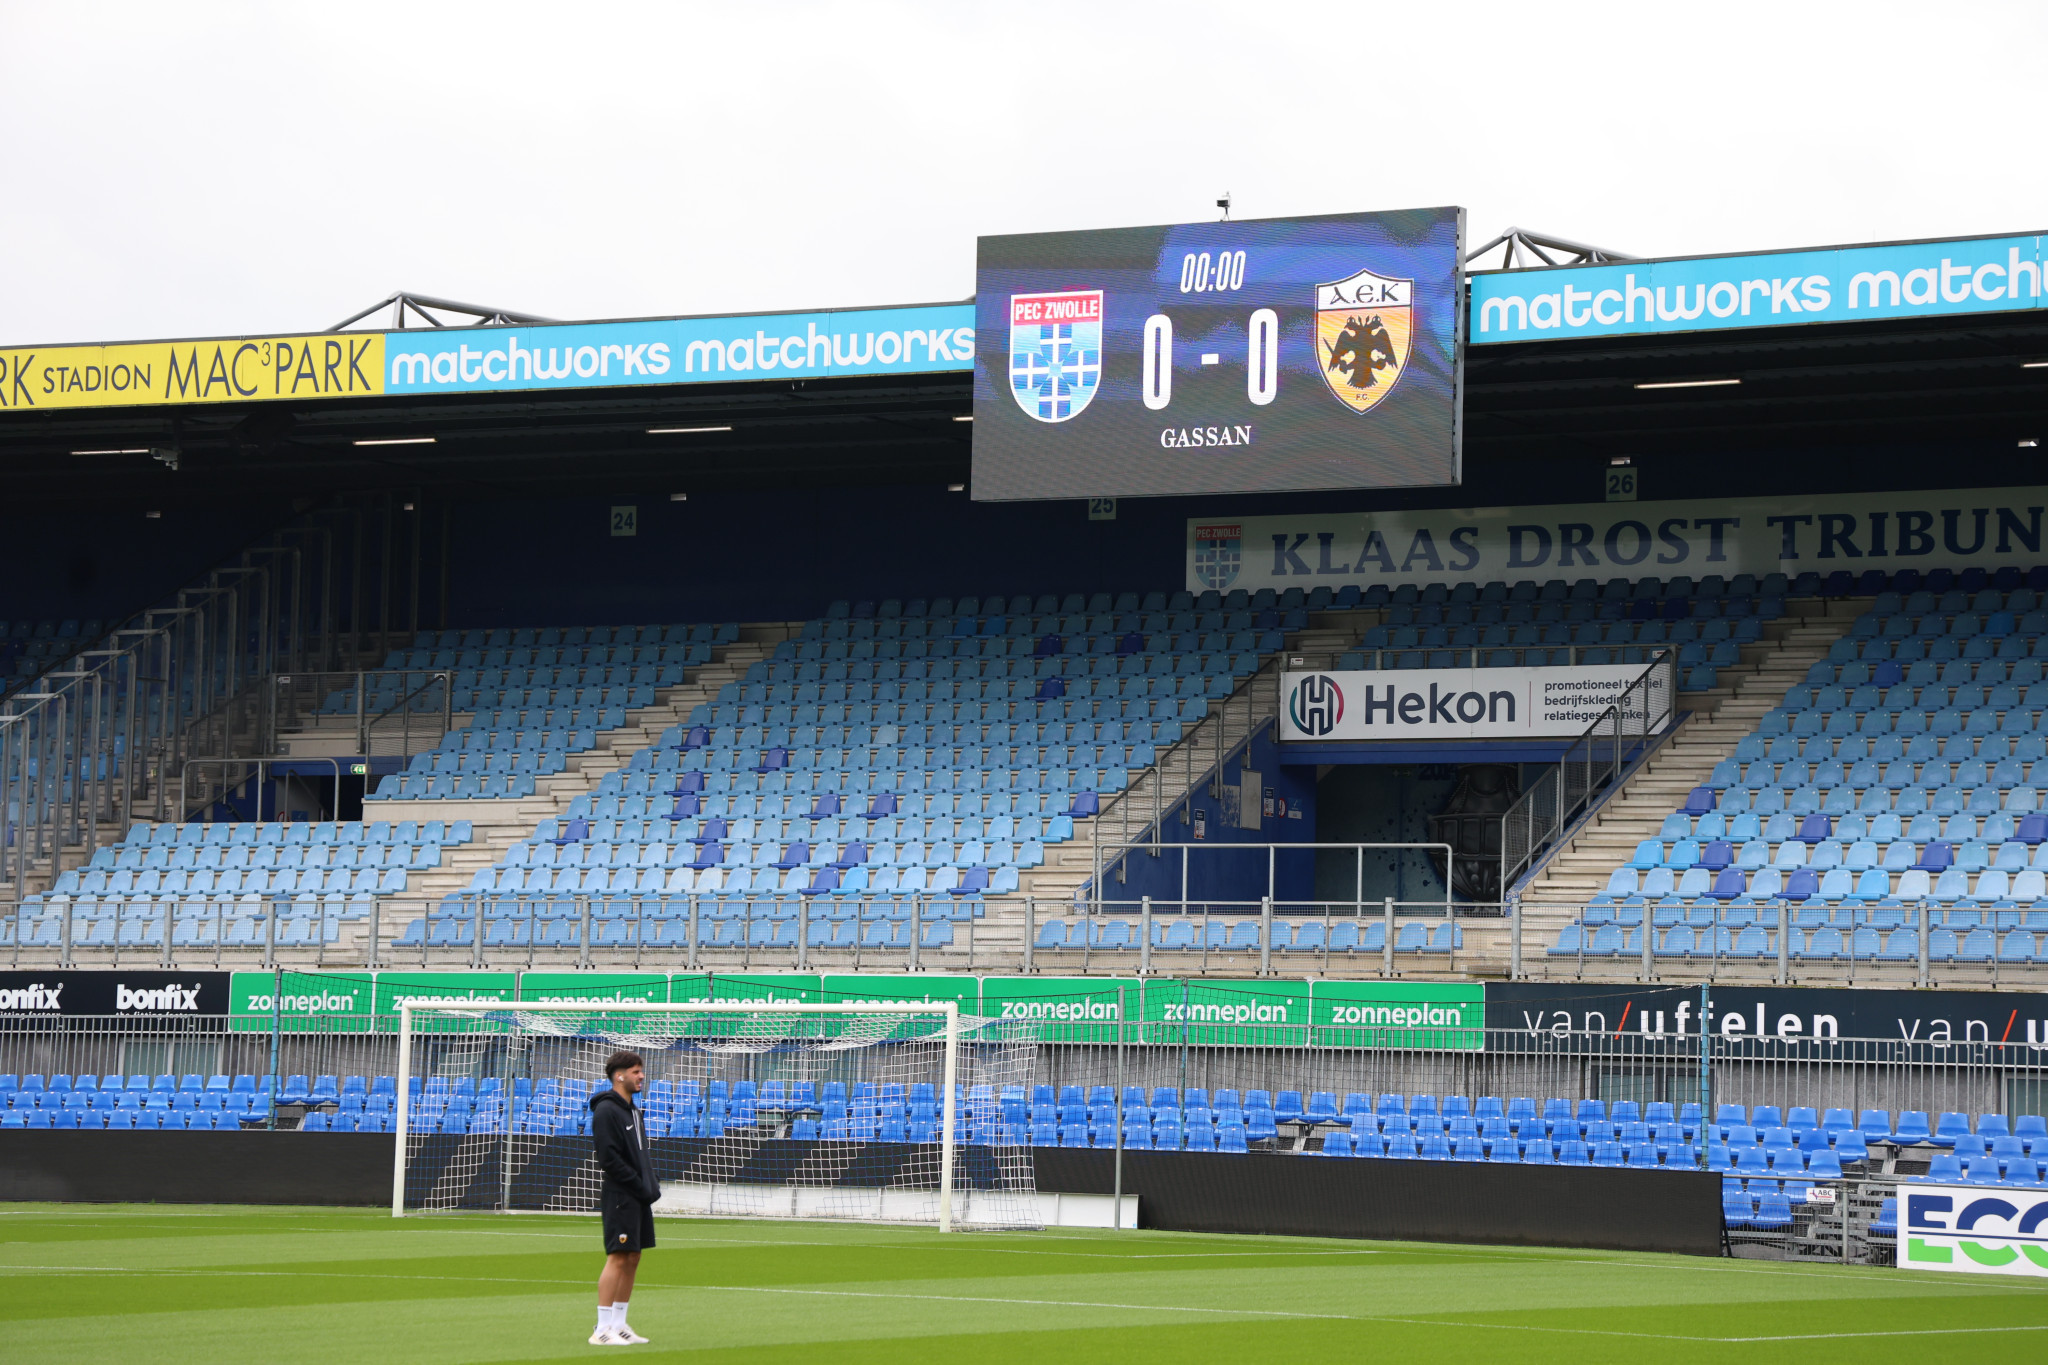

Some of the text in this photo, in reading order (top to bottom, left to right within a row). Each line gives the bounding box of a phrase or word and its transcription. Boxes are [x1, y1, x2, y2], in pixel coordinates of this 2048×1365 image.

[1180, 250, 1246, 293] 00:00
[1480, 246, 2048, 332] matchworks match
[1015, 299, 1098, 320] PEC ZWOLLE
[391, 322, 975, 385] matchworks matchworks
[1143, 314, 1172, 410] 0
[1248, 308, 1278, 405] 0
[43, 363, 151, 394] STADION
[1160, 425, 1251, 448] GASSAN
[1609, 474, 1634, 495] 26
[1091, 498, 1114, 514] 25
[613, 512, 634, 530] 24
[1196, 527, 1241, 539] PEC ZWOLLE
[1271, 506, 2045, 576] KLAAS DROST TRIBUN
[1544, 678, 1663, 693] promotioneel texiel
[1365, 682, 1516, 725] Hekon
[1001, 996, 1119, 1021] zonneplan
[1163, 998, 1288, 1024] zonneplan
[1332, 1001, 1462, 1028] zonneplan
